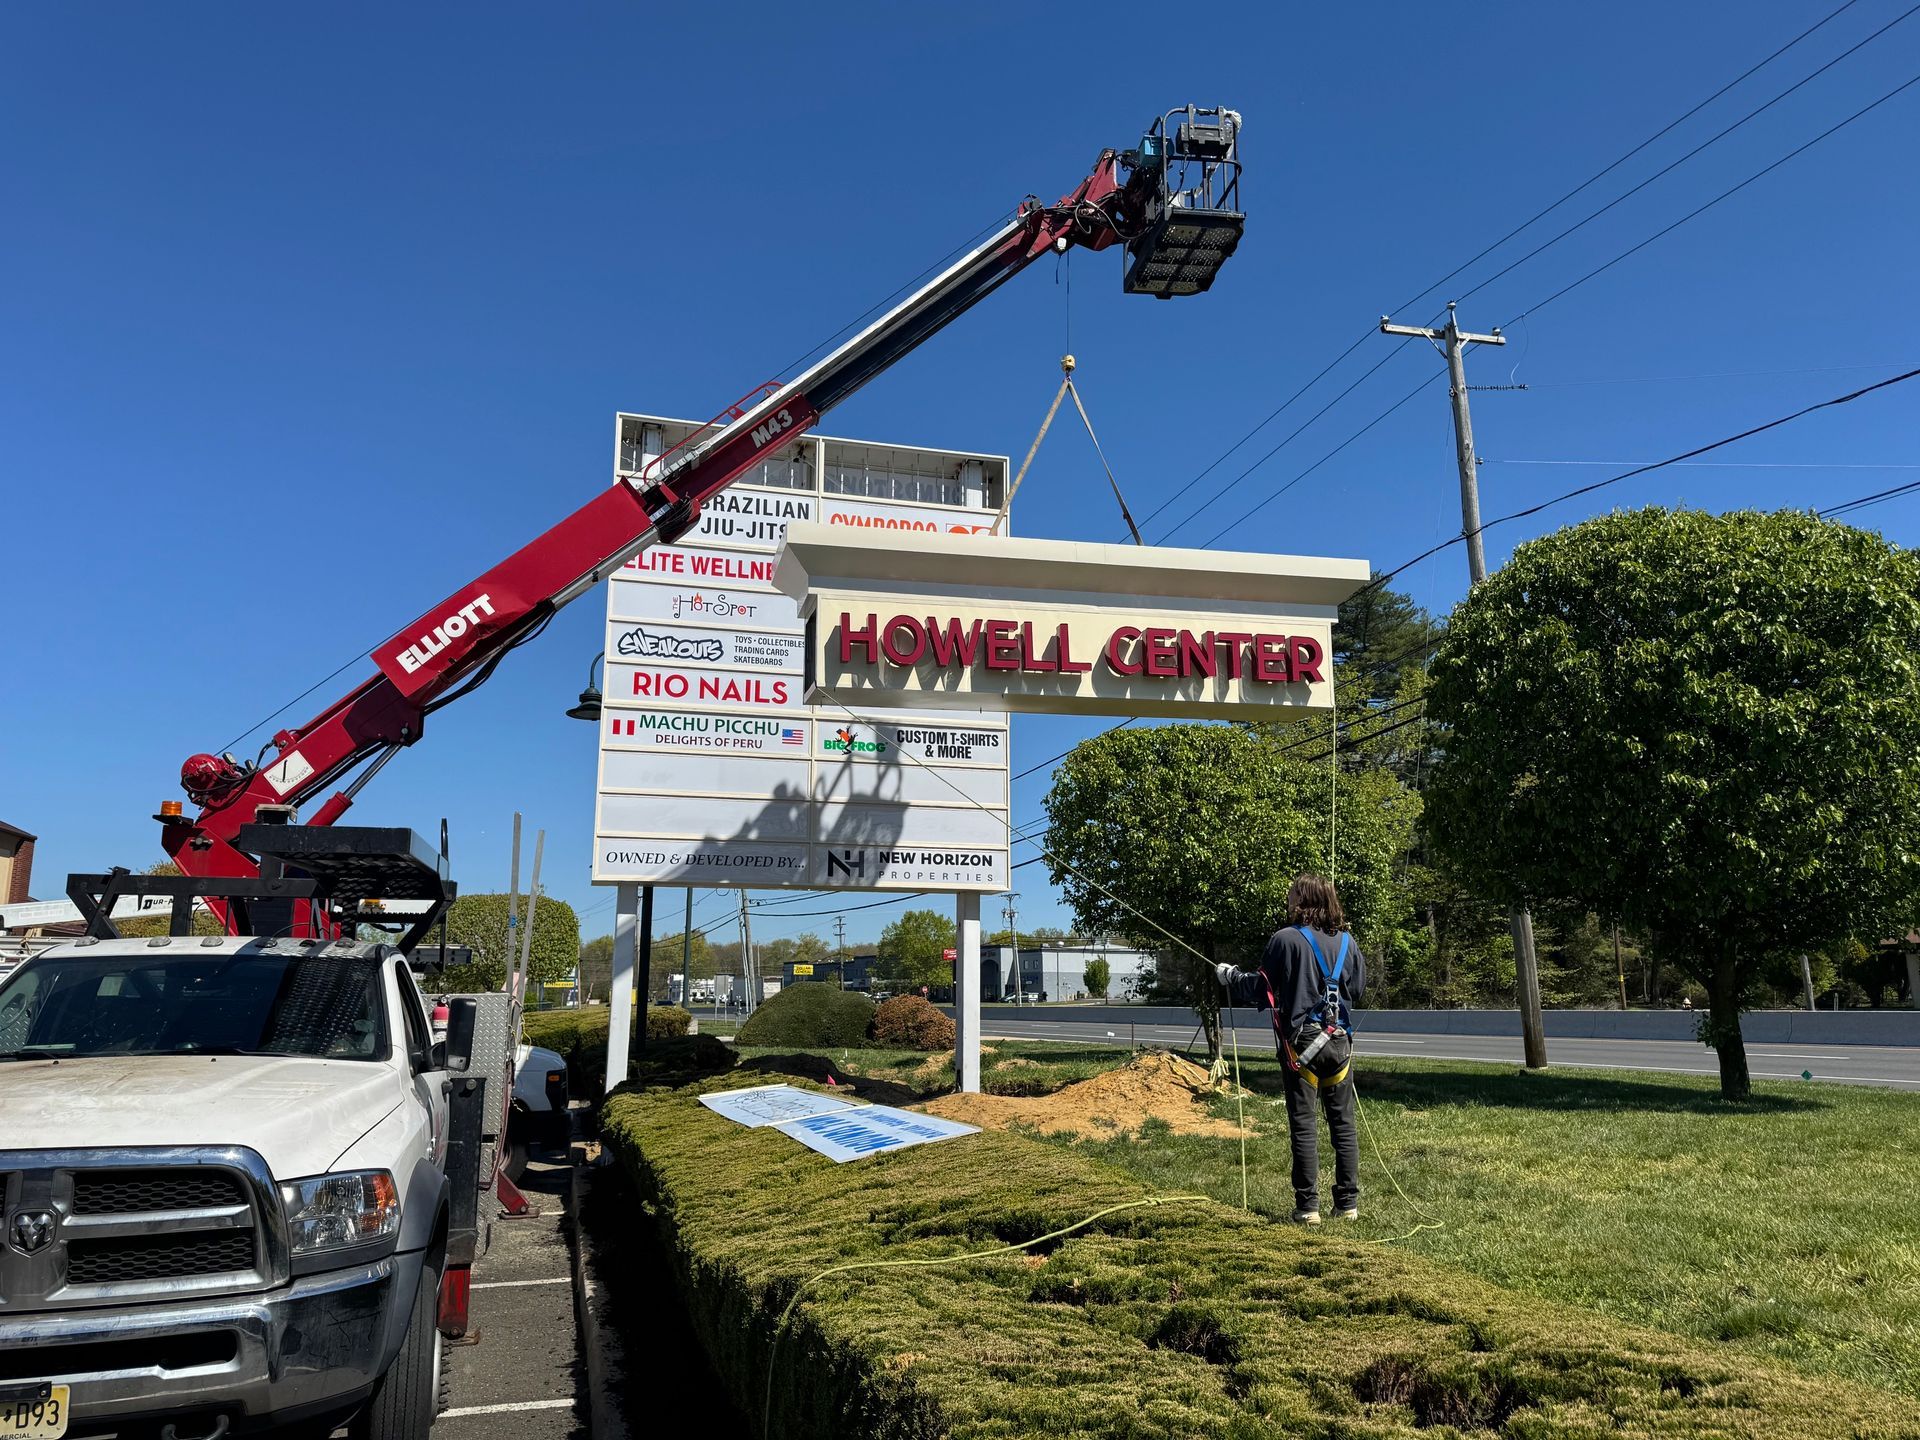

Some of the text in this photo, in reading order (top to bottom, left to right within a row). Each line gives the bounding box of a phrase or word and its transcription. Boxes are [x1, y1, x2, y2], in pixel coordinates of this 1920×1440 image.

[751, 409, 793, 448] M43
[395, 593, 496, 675] ELLIOTT
[735, 635, 752, 645] TOYS
[618, 627, 724, 662] SNEAKOUTS
[734, 645, 789, 657] TRADING CARDS
[839, 612, 1325, 684] HOWELL CENTER
[733, 655, 783, 667] SKATEBOARDS
[632, 671, 788, 705] RIO NAILS
[639, 714, 780, 736] MACHU PICCHU
[655, 734, 763, 749] DELIGHTS OF PERU
[823, 739, 886, 754] BIG FROG
[896, 729, 999, 747] CUSTOM T-SHIRTS
[924, 745, 972, 759] & MORE
[606, 851, 805, 869] OWNED & DEVELOPED BY...
[879, 851, 993, 867] NEW HORIZON
[878, 871, 994, 882] PROPERTIES
